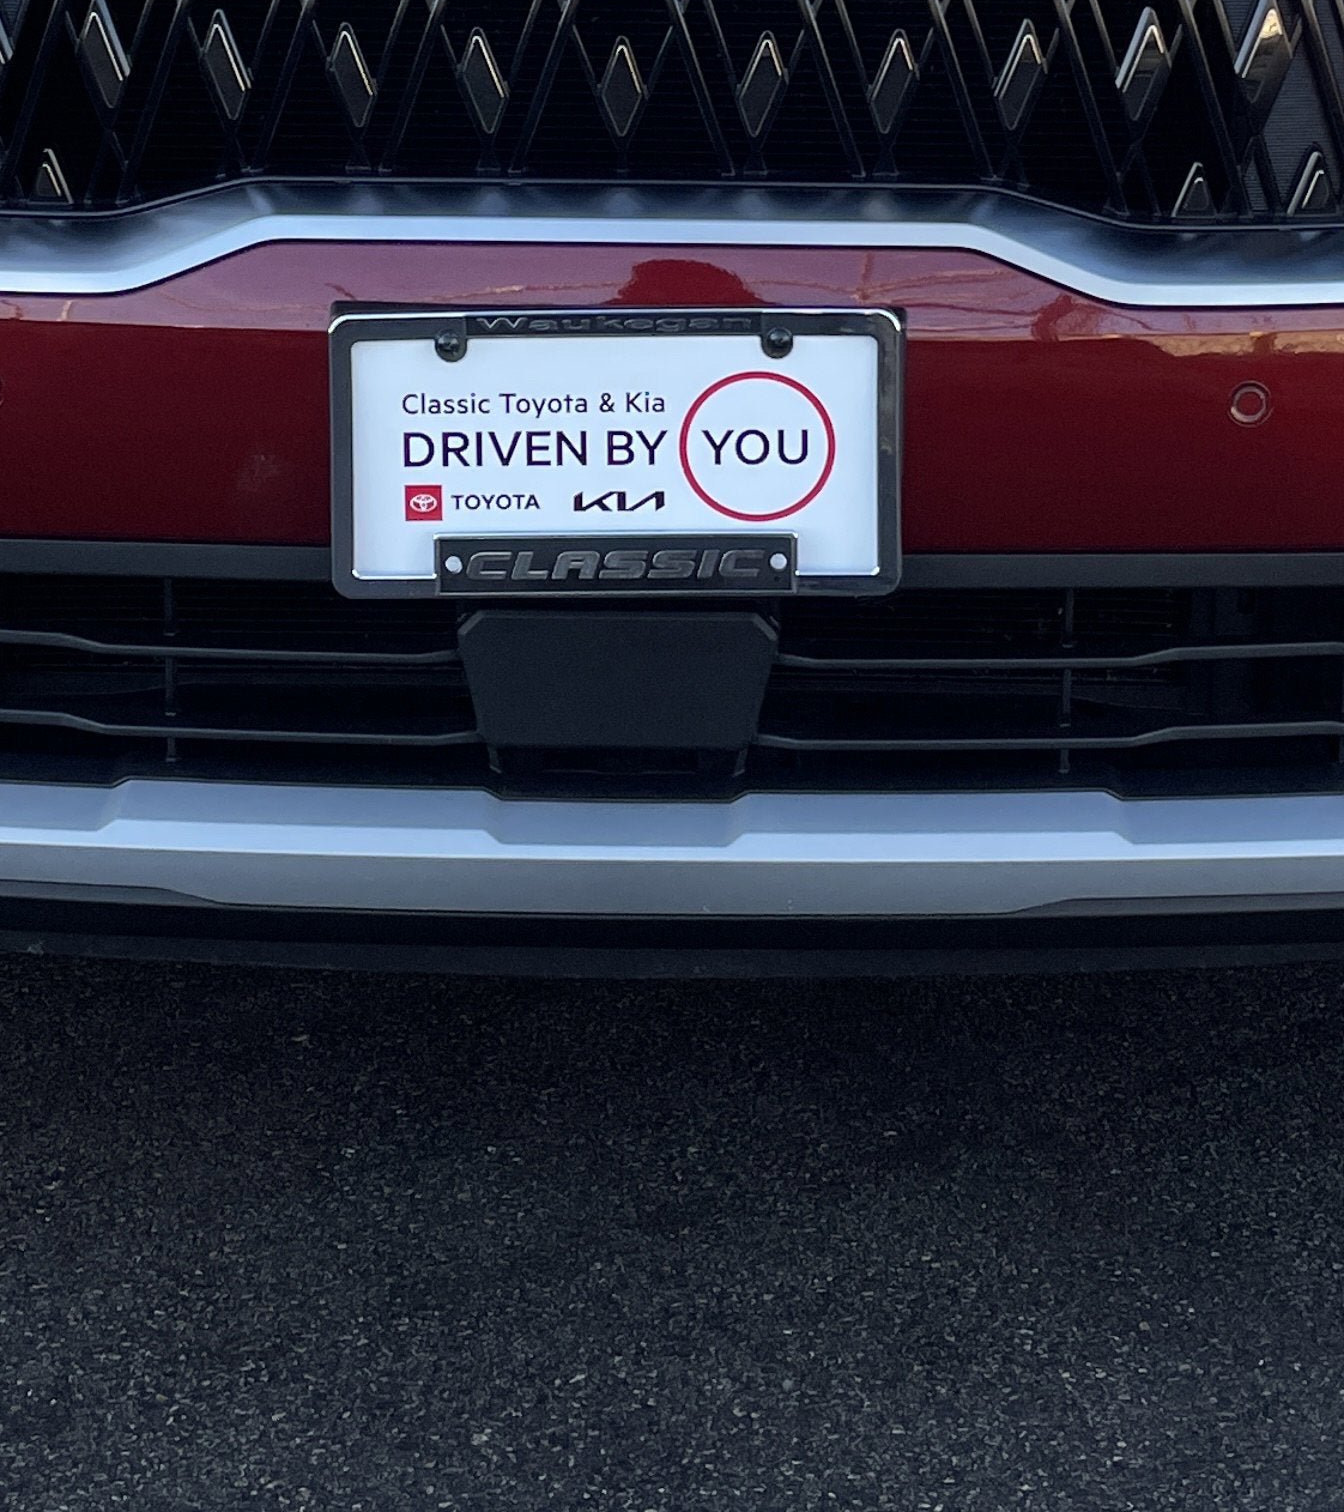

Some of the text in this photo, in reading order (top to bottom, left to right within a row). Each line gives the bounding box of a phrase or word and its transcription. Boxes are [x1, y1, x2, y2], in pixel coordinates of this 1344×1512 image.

[475, 315, 753, 332] Waukegan
[402, 391, 665, 419] Classic Toyota & Kia
[403, 429, 809, 467] DRIVEN BY YOU
[450, 494, 541, 511] TOYOTA
[573, 490, 666, 512] KIA
[465, 549, 766, 581] CLASSIC
